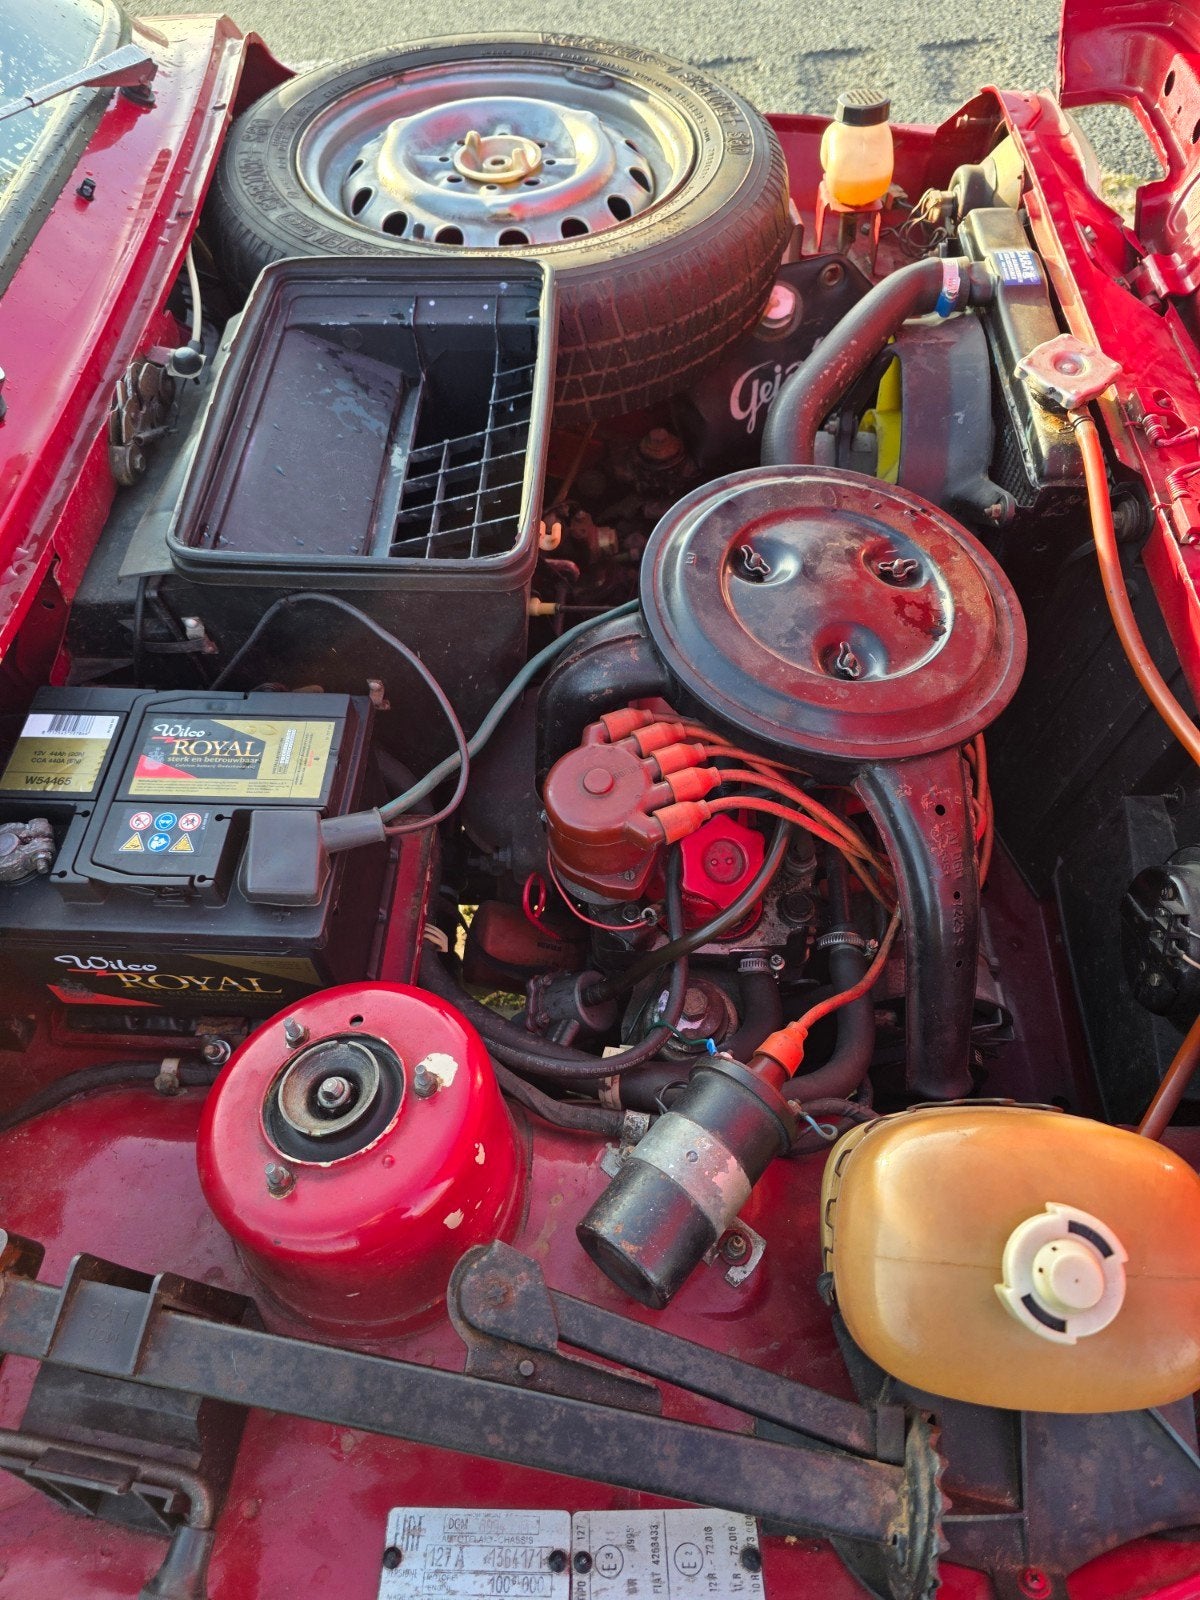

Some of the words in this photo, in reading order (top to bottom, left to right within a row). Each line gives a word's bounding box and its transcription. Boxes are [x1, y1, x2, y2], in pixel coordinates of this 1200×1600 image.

[153, 723, 206, 739] Wilco
[171, 740, 262, 757] ROYAL
[204, 756, 259, 764] betrouwbaar
[24, 776, 73, 786] W54465
[53, 954, 158, 973] Wilco
[114, 972, 284, 995] ROYAL
[576, 1525, 586, 1541] 127
[728, 1526, 739, 1556] 72.016
[429, 1546, 451, 1568] 127
[650, 1571, 663, 1594] FIAT
